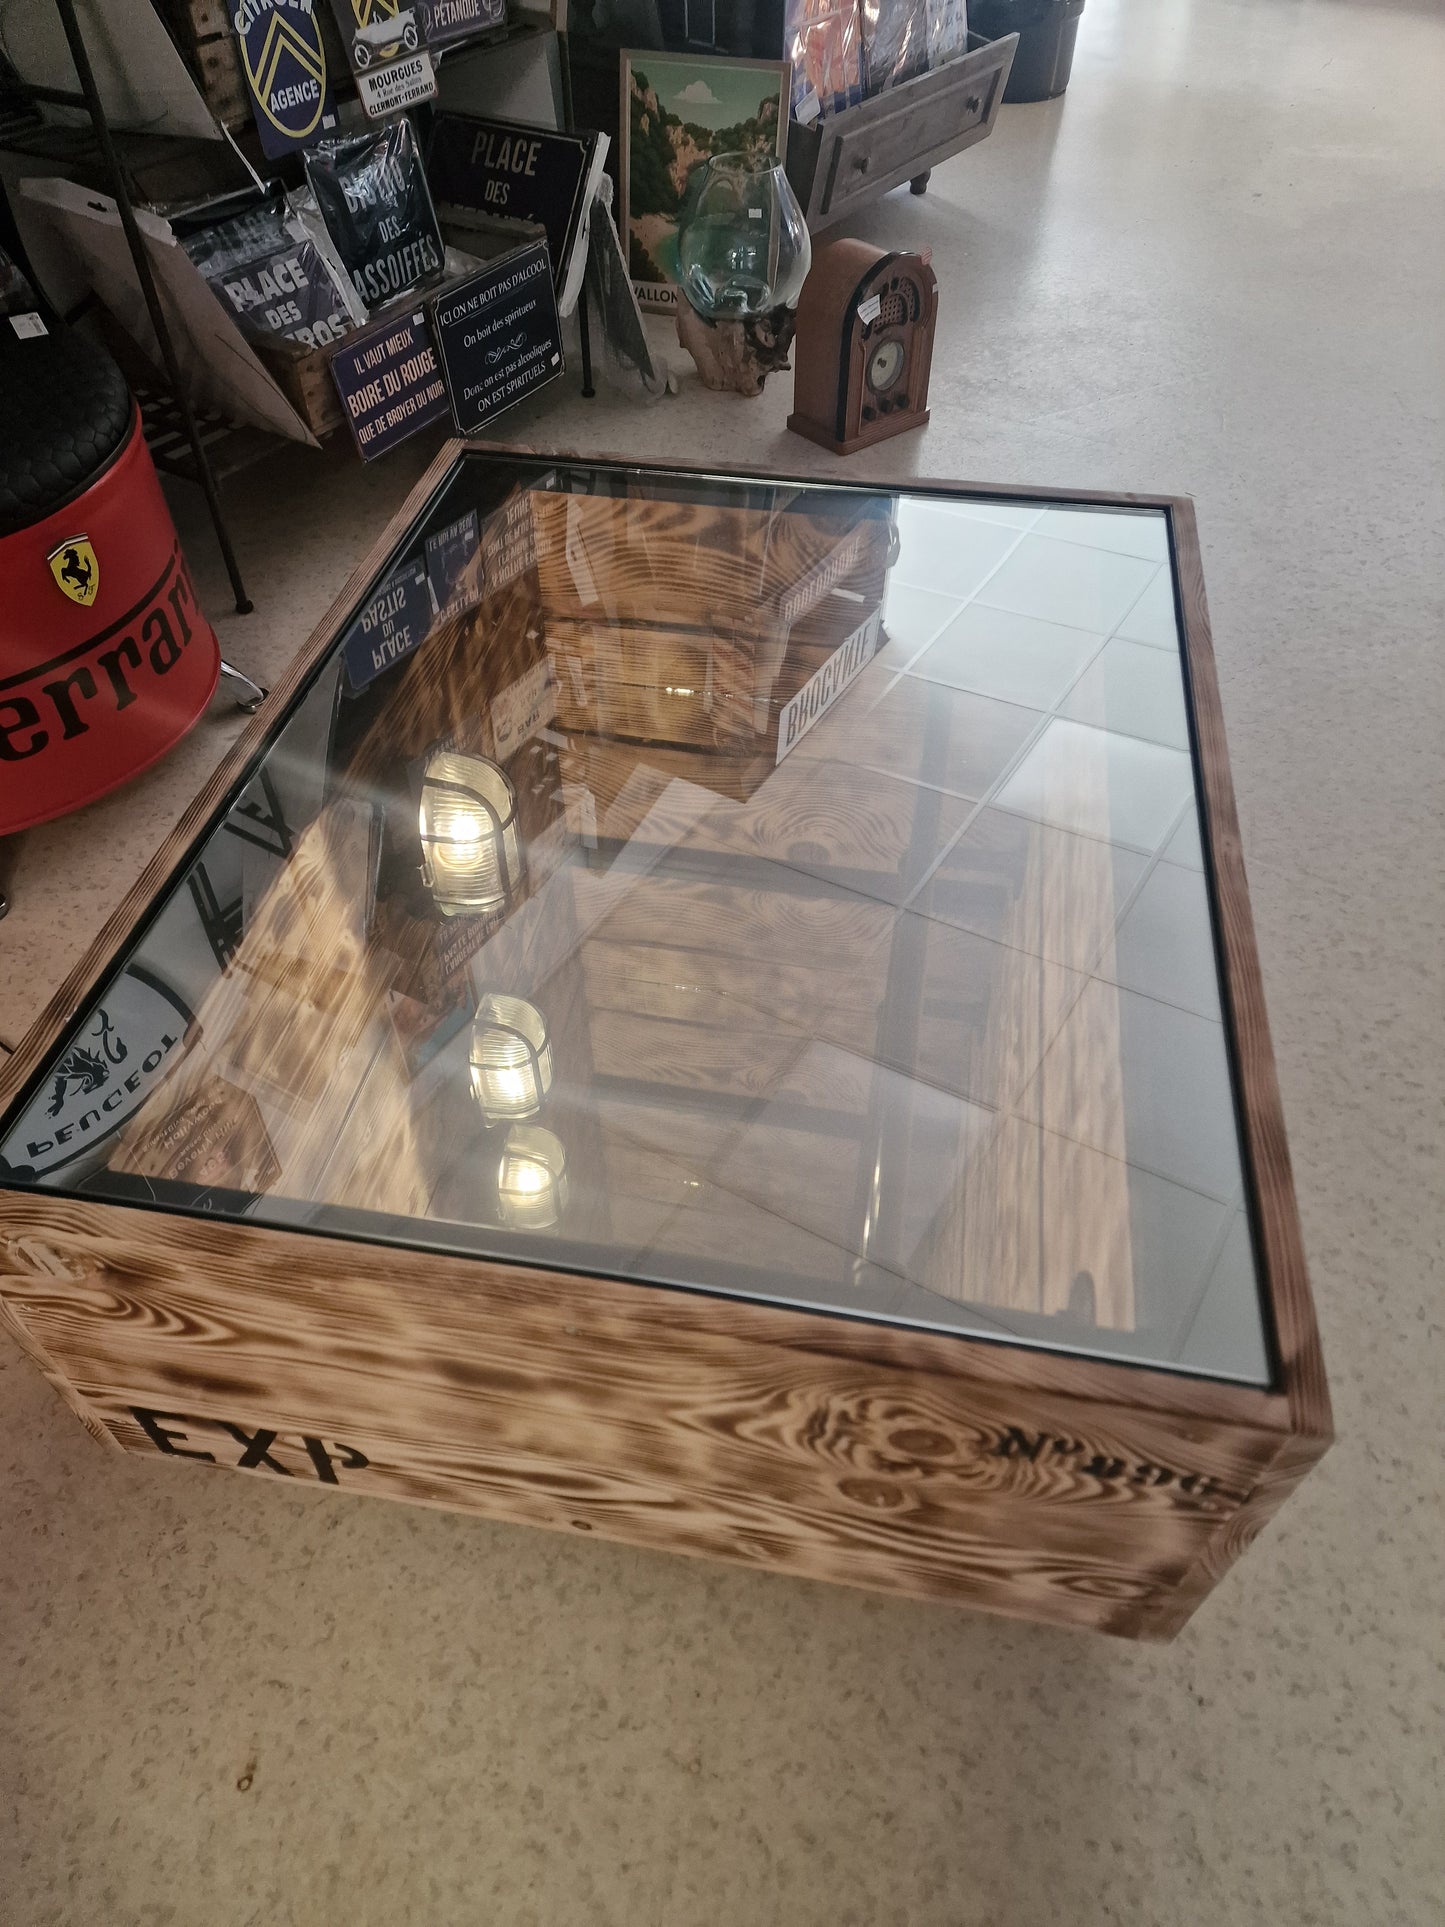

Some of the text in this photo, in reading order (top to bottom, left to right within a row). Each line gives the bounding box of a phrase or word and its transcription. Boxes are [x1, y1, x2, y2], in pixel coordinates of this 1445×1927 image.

[235, 0, 312, 35] CITN
[270, 79, 319, 113] AGENCE
[368, 60, 423, 92] MOURGUES
[369, 82, 434, 115] CLERMONT-FERRAND
[471, 131, 542, 177] PLACE
[484, 179, 511, 205] DES
[378, 215, 401, 244] DES
[223, 257, 310, 313] PLACE
[351, 231, 440, 303] ASSOIFFÉS
[264, 300, 302, 330] DES
[440, 258, 546, 326] ICI ON NE BOIT PAS D'ALCOOL
[284, 313, 348, 350] ROS
[463, 299, 537, 348] On boit des spiritueux
[353, 327, 414, 375] IL VAUT MIEUX
[463, 338, 552, 400] Donc on est pas alcooliques
[347, 347, 437, 418] BOIRE DU ROUGE
[477, 360, 546, 412] ON EST SPIRITUELS
[358, 379, 445, 445] QUE DE BROYER DU NOIR
